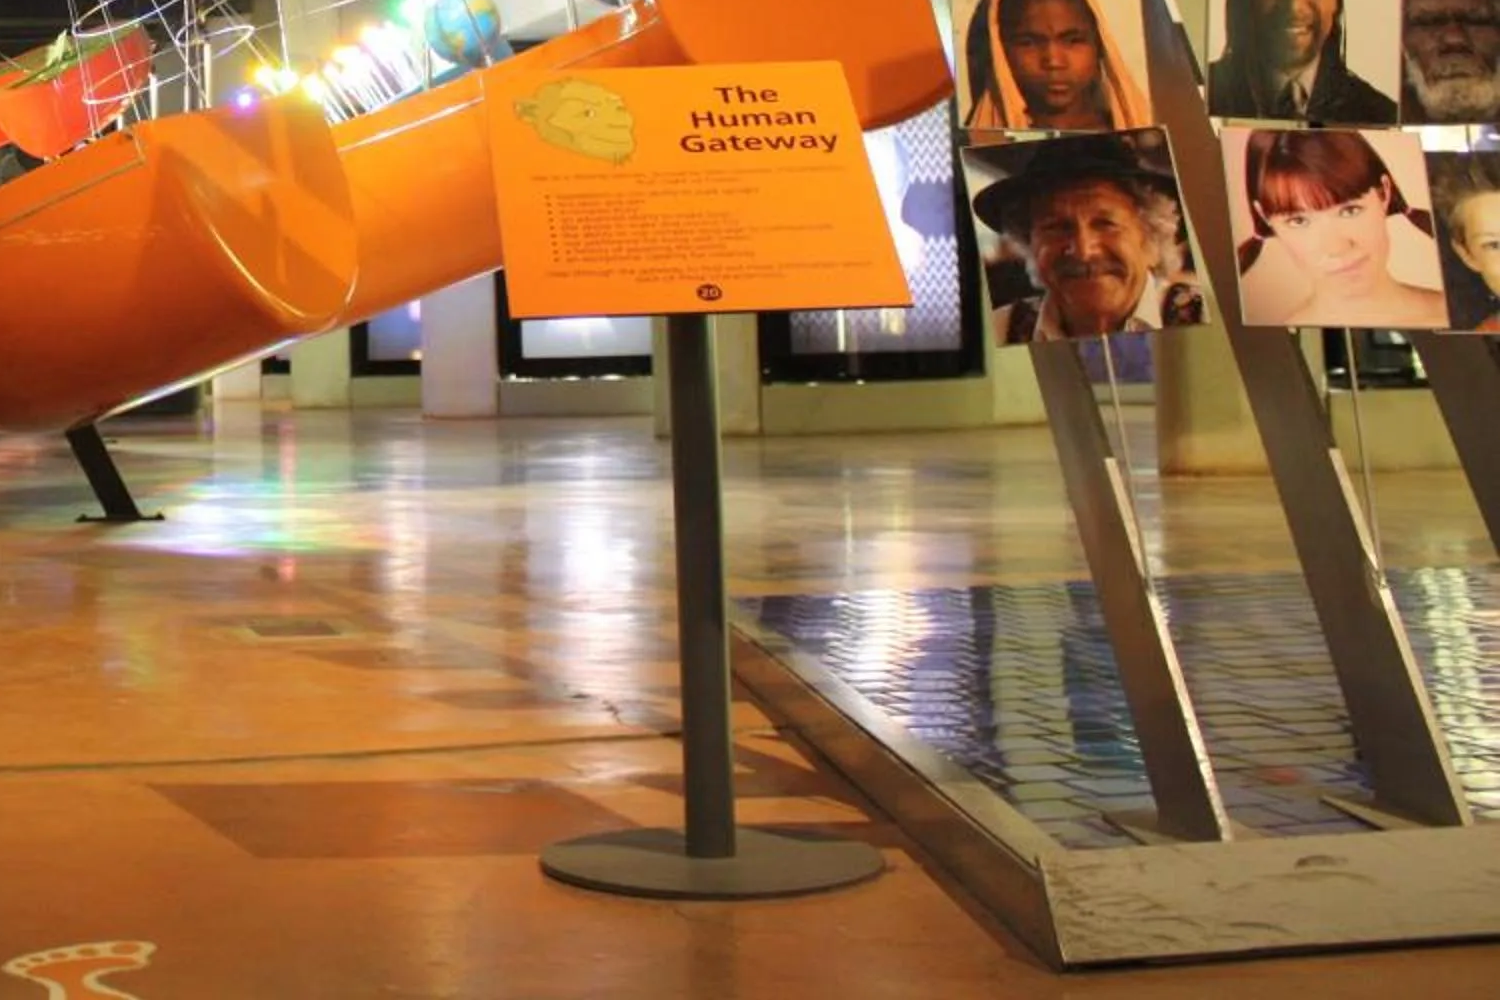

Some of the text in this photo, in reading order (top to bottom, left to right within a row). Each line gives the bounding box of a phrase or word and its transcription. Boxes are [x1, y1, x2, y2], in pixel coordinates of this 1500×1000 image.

[713, 85, 779, 104] The
[690, 110, 816, 129] Human
[679, 133, 837, 153] Gateway
